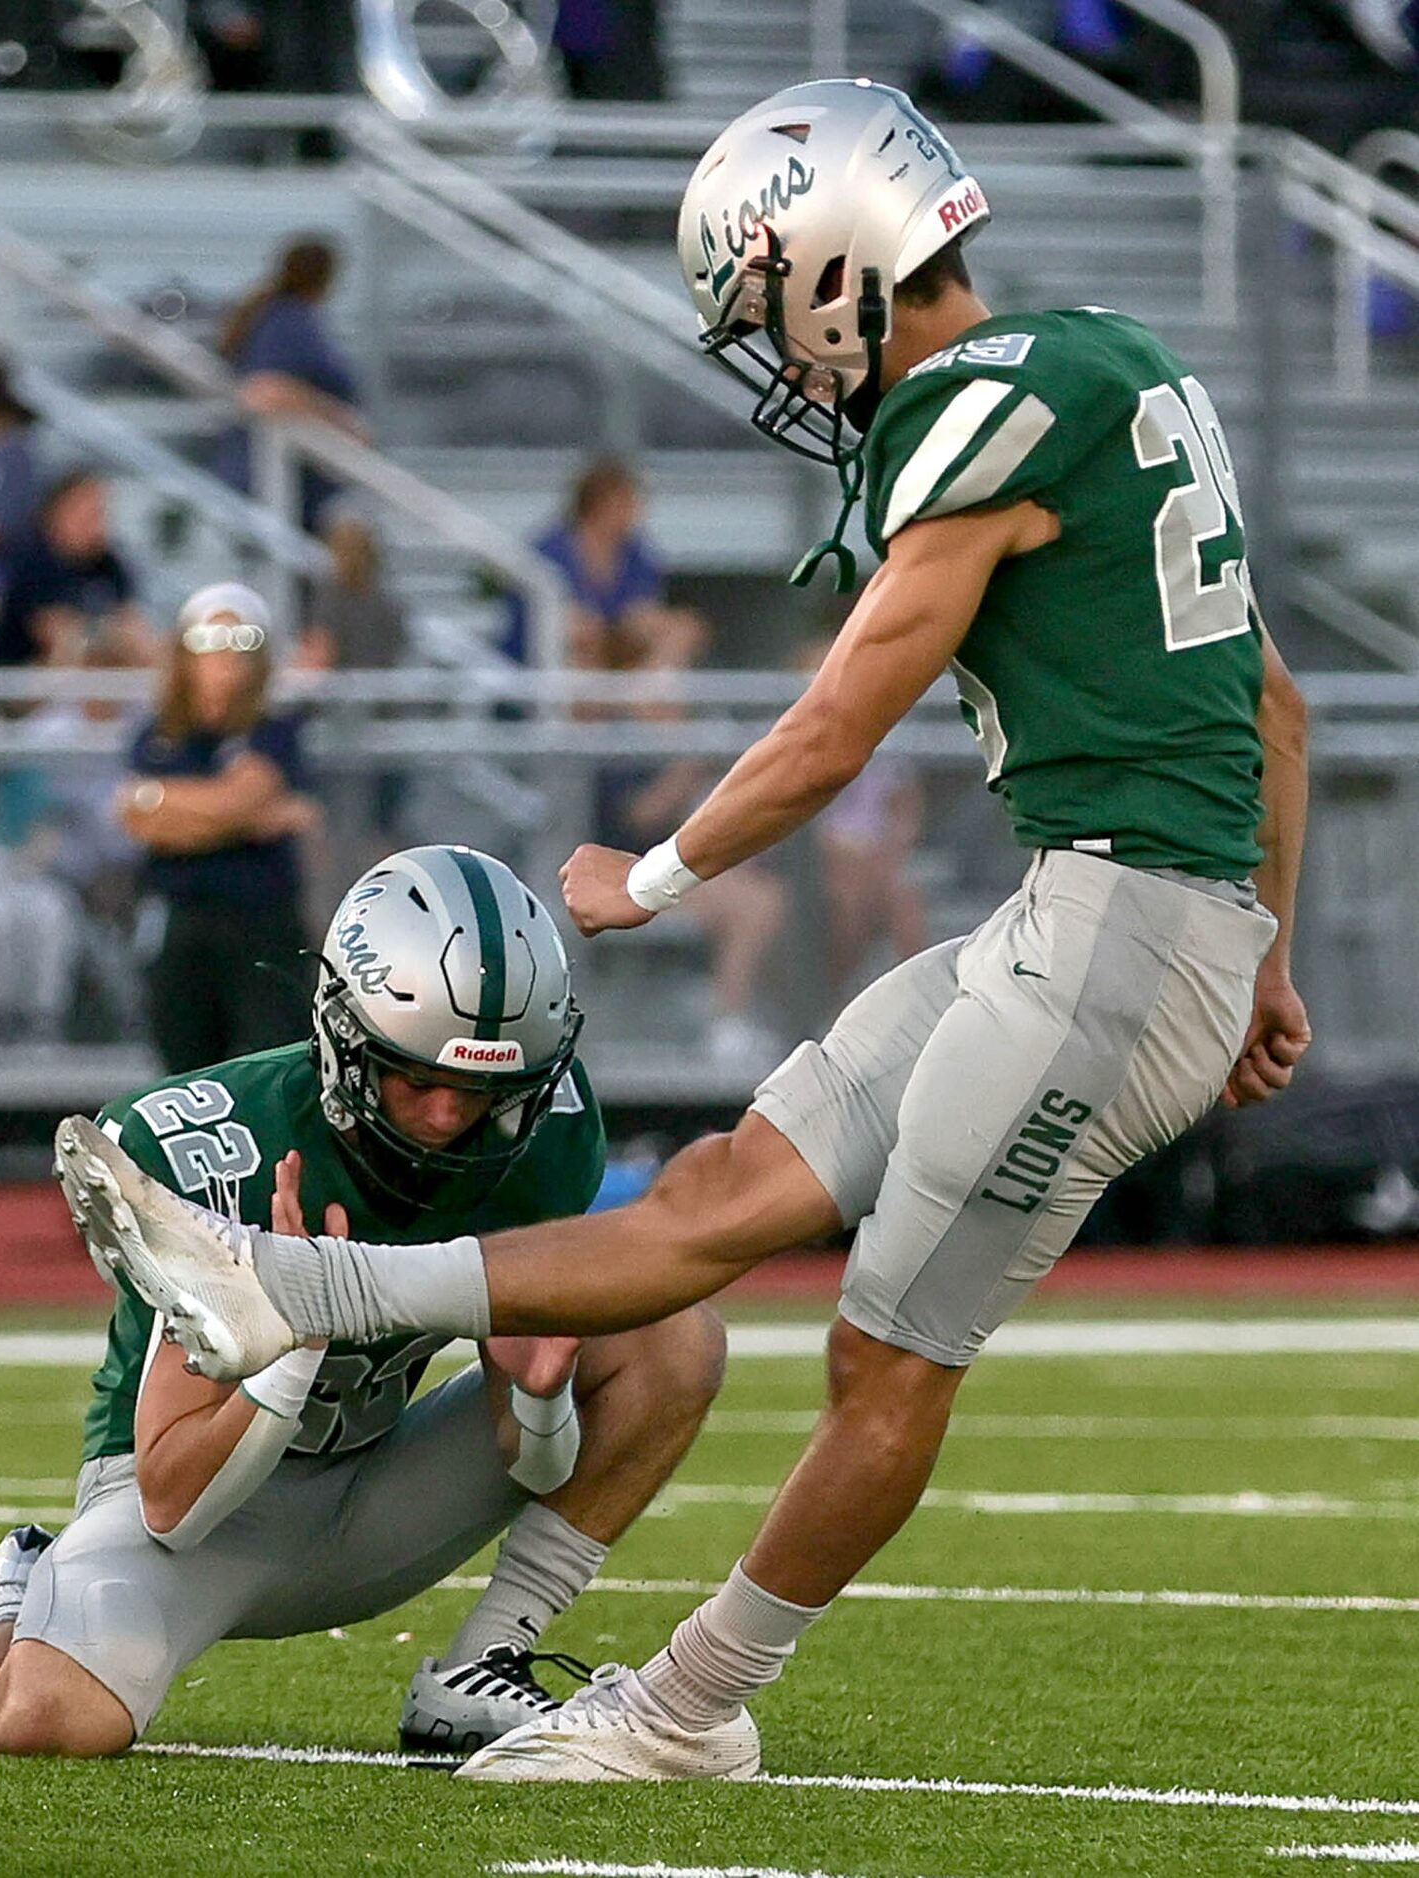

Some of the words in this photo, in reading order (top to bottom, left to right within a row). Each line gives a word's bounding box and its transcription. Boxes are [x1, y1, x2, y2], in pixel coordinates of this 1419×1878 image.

[698, 154, 816, 305] Lions
[453, 1045, 518, 1063] Riddell
[131, 1079, 262, 1193] 22
[981, 1088, 1092, 1214] LIONS
